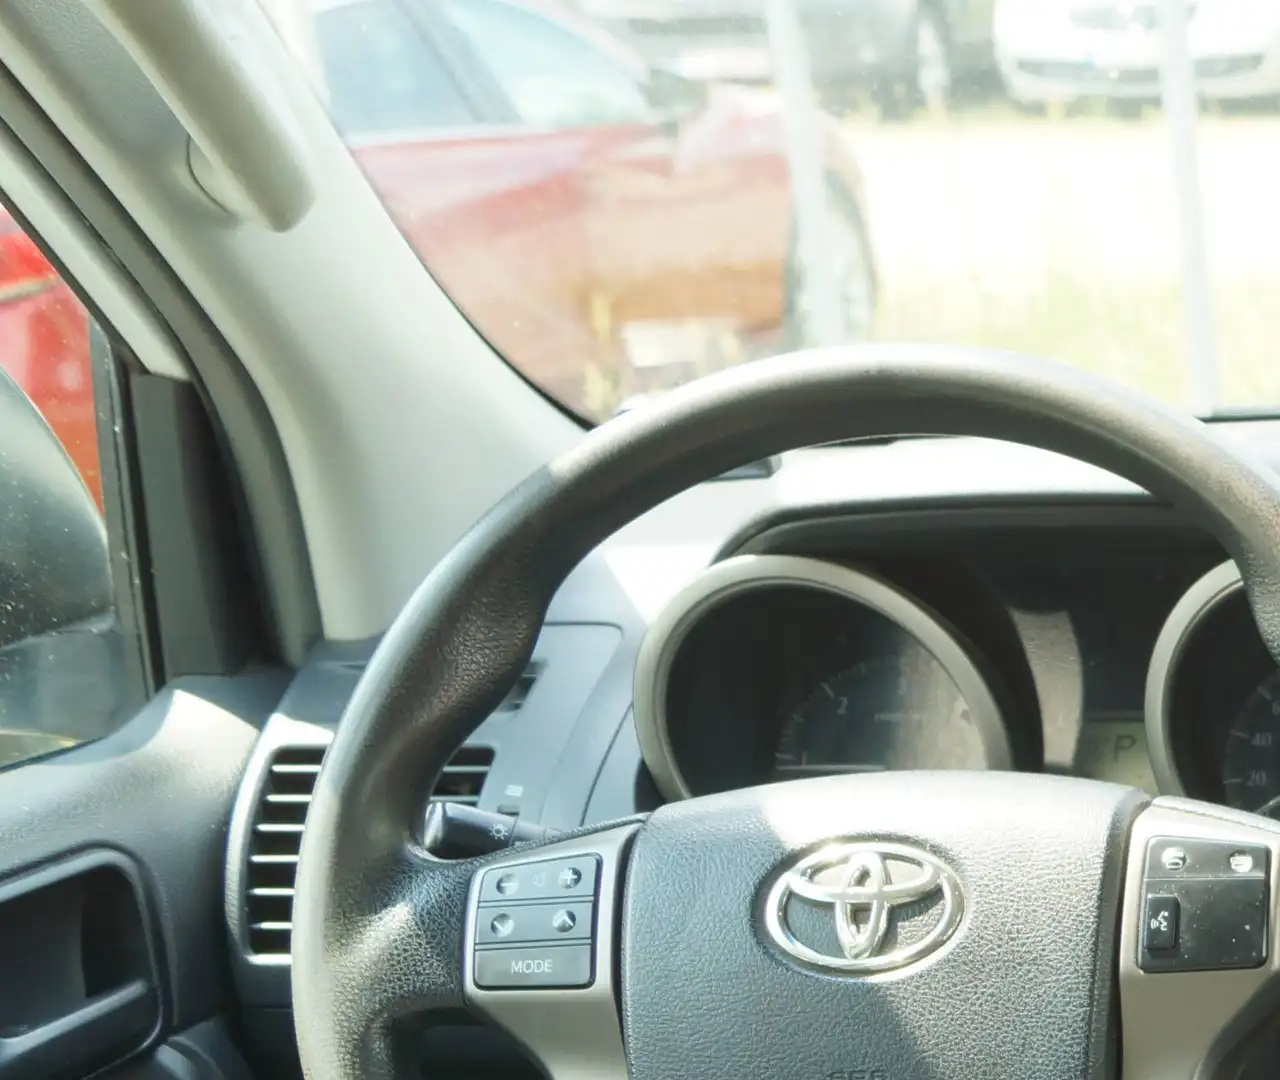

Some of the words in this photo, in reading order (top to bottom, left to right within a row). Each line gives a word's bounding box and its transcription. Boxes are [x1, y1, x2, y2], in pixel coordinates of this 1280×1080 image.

[1251, 732, 1273, 747] 40
[1114, 734, 1137, 763] P
[1246, 771, 1267, 786] 20
[511, 959, 553, 974] MODE
